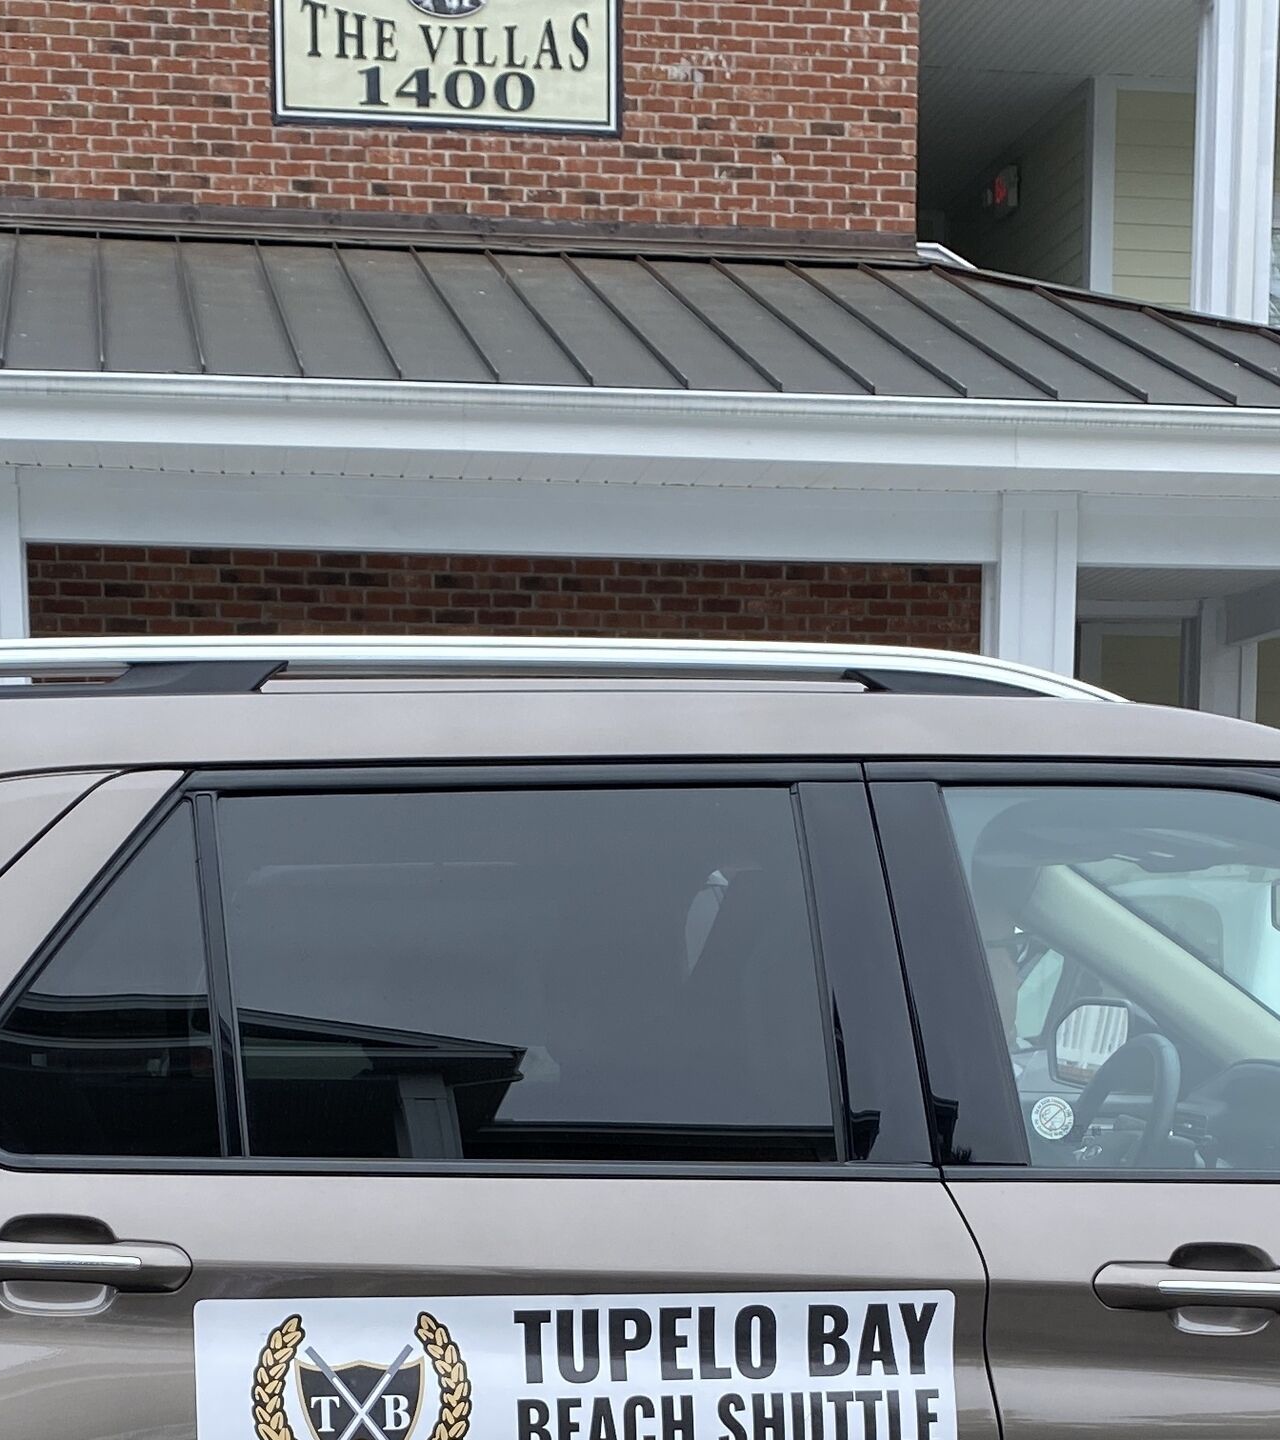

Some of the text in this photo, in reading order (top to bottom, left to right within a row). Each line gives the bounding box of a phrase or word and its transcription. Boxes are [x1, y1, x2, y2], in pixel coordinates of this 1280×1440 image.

[300, 0, 591, 72] THE VILLAS
[358, 65, 536, 112] 1400
[513, 1302, 938, 1385] TUPELO BAY
